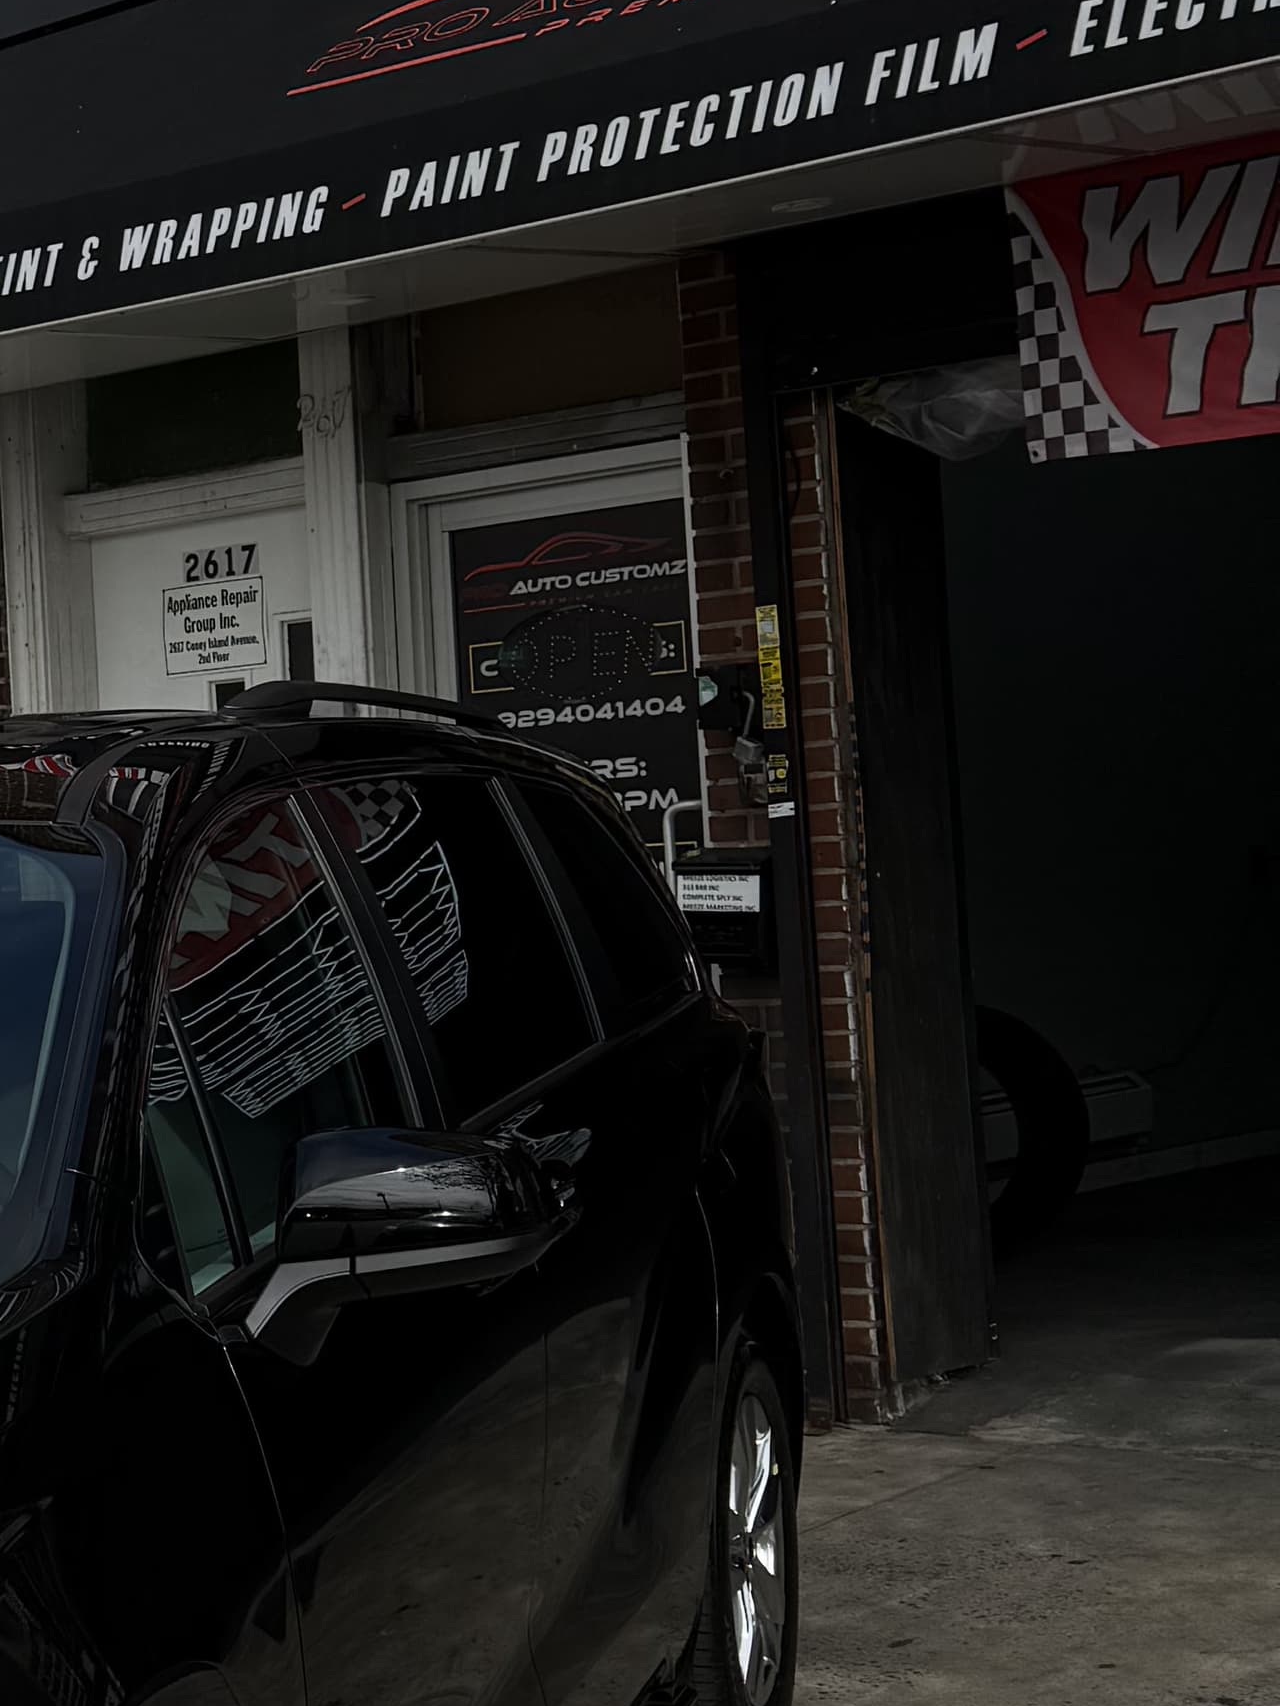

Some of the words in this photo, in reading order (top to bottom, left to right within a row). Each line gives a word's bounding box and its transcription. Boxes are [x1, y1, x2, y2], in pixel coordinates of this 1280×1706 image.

[306, 7, 489, 74] PRO
[77, 237, 100, 281] &
[120, 185, 329, 272] WRAPPING
[380, 140, 520, 217] PAINT
[536, 62, 845, 184] PROTECTION
[864, 21, 1000, 107] FILM
[1082, 154, 1280, 293] WI
[185, 544, 256, 582] 2617
[509, 574, 573, 596] AUTO
[575, 558, 688, 587] CUSTOMZ
[167, 594, 217, 616] Appliance
[221, 585, 258, 608] Repair
[184, 616, 216, 634] Group
[220, 613, 239, 629] Inc.
[208, 636, 229, 649] Island
[497, 695, 687, 729] 9294041404
